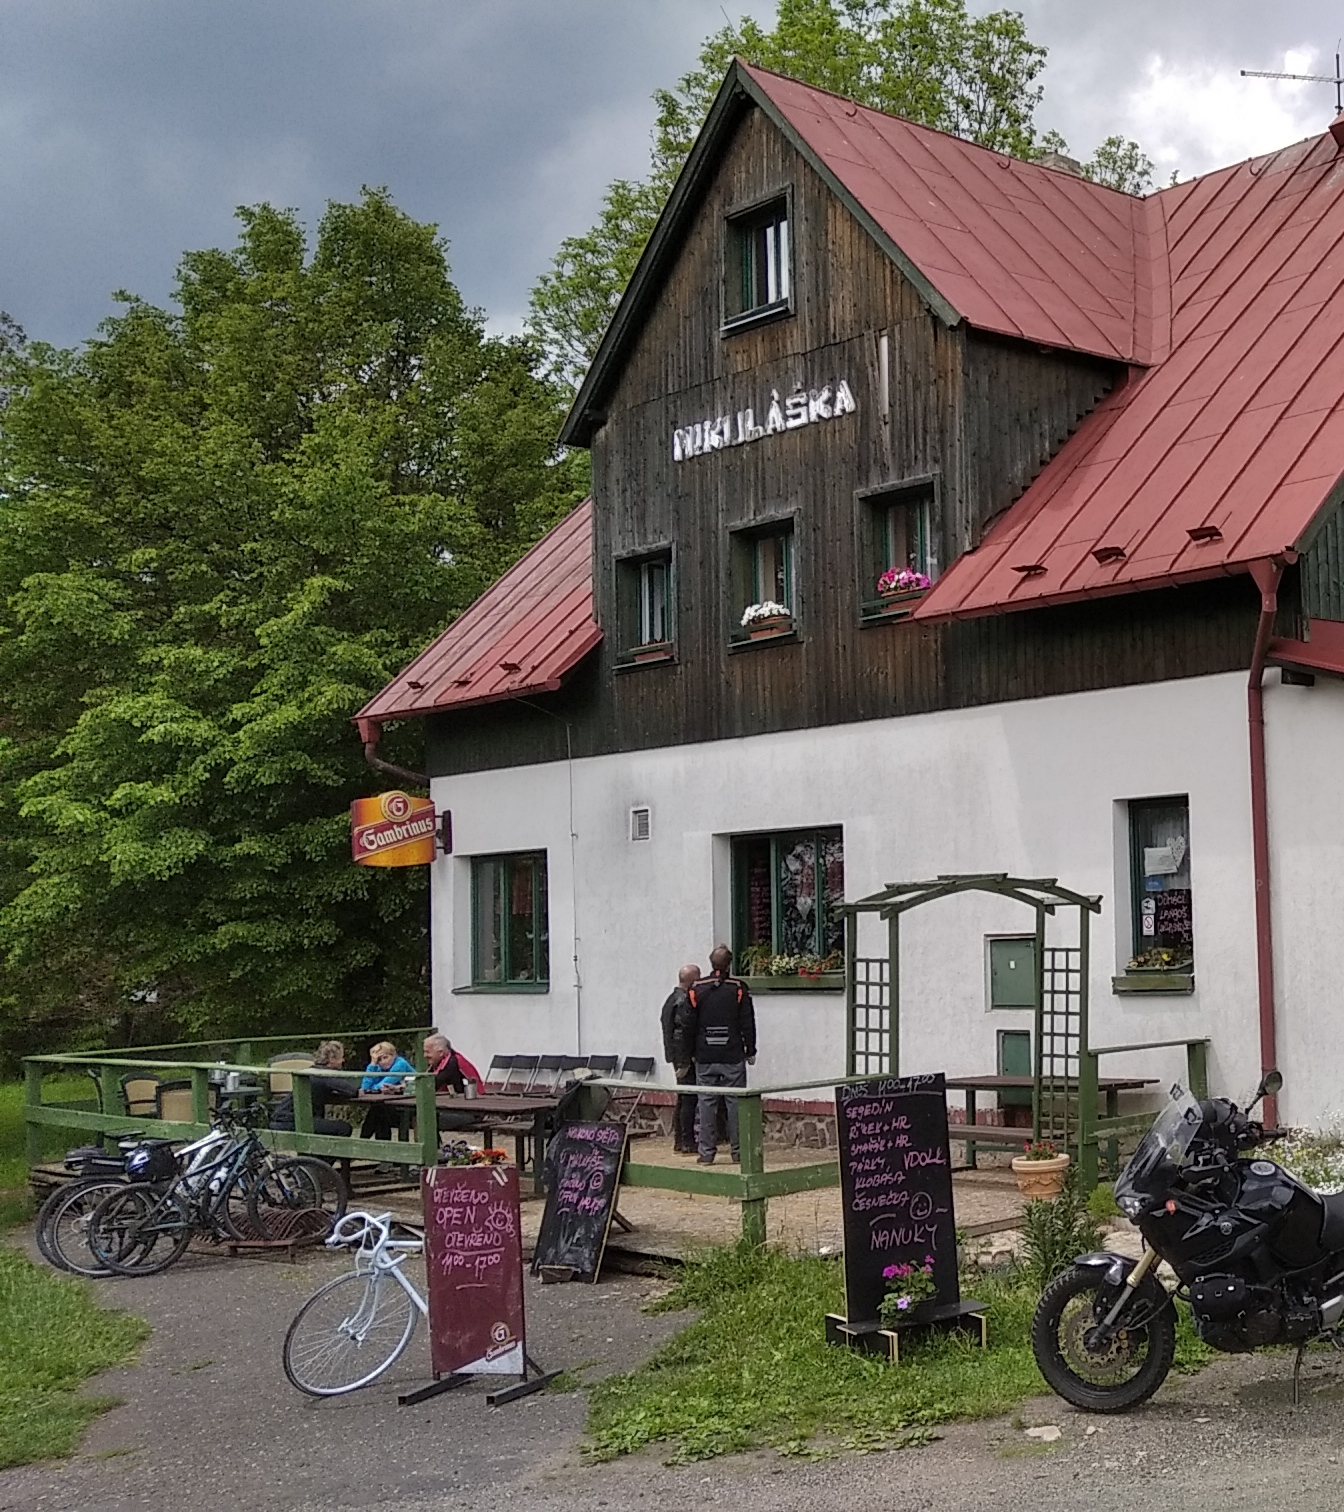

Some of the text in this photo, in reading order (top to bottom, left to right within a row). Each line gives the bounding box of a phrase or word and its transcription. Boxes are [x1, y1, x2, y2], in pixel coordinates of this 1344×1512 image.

[359, 817, 434, 850] Gambrinus
[433, 1182, 489, 1203] OTEVŘENO
[436, 1205, 476, 1227] OPEN
[445, 1226, 502, 1249] OTEVŘENO
[870, 1223, 938, 1250] NANUKY
